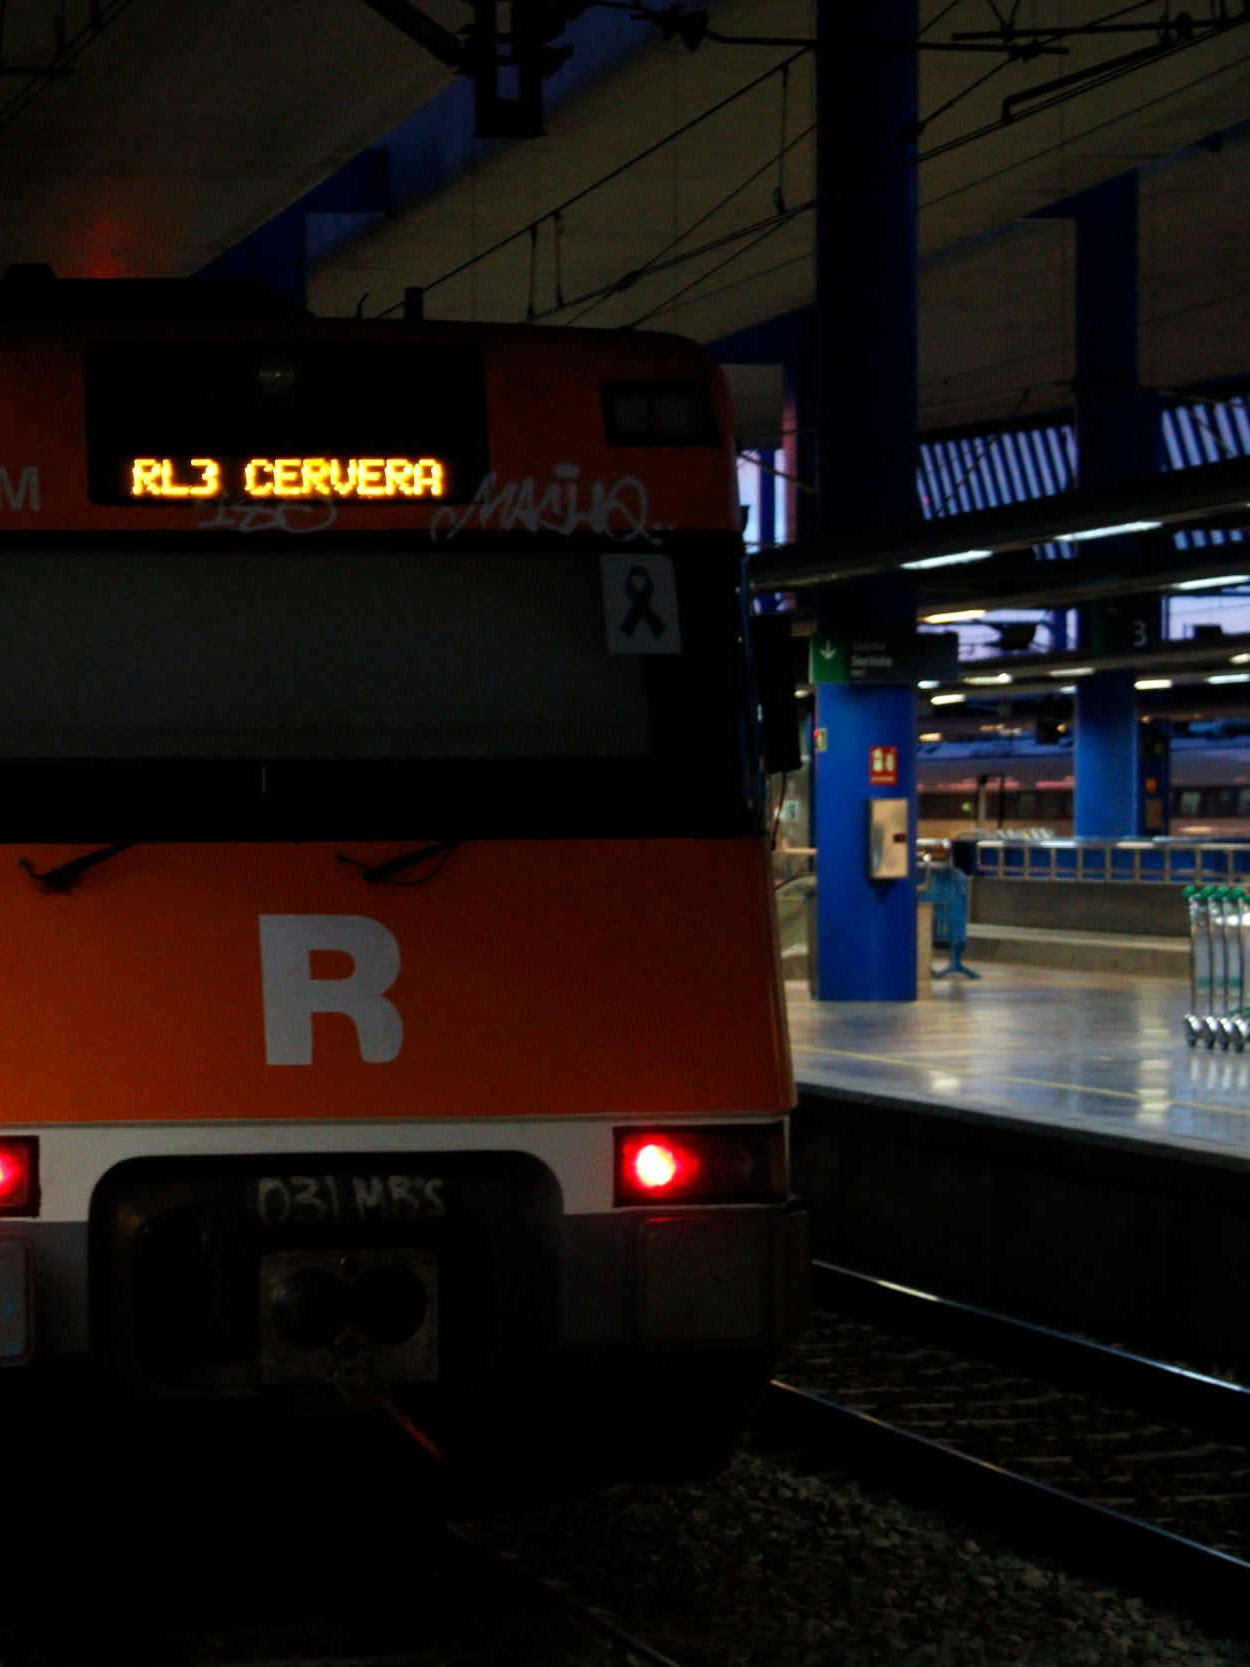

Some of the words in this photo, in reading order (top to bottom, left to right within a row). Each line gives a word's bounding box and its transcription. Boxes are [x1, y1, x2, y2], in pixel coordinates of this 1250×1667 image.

[132, 457, 219, 497] RL3
[244, 457, 443, 497] CERVERA
[1131, 619, 1149, 648] 3
[258, 913, 405, 1067] R
